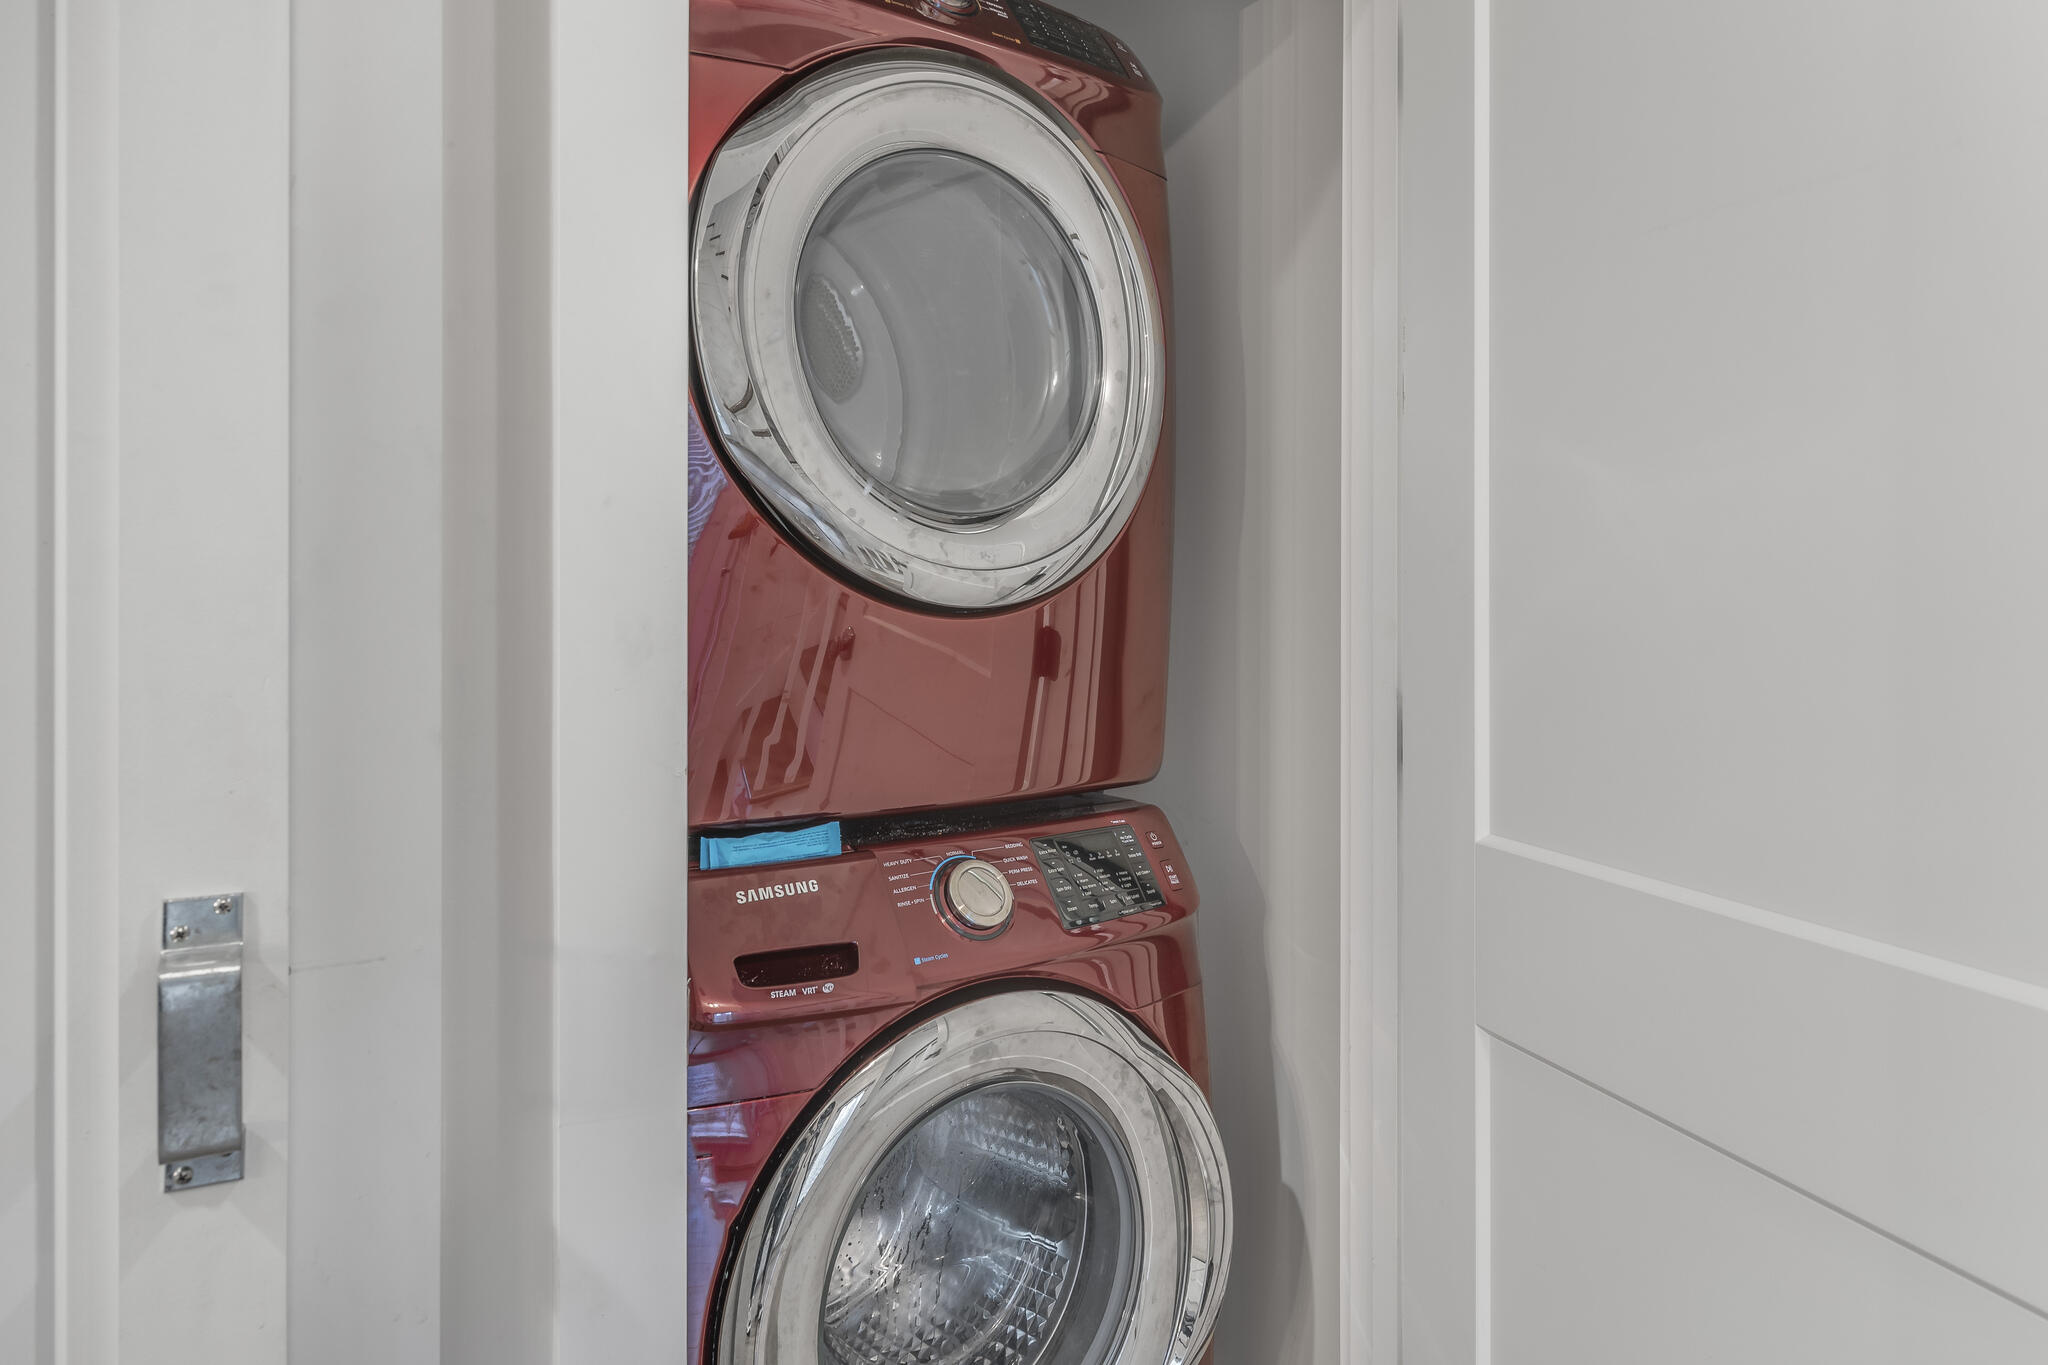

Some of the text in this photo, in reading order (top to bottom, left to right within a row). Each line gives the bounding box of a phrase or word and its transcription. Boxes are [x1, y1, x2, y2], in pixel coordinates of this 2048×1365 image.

[888, 873, 910, 881] SANITIZE
[736, 880, 819, 904] SAMSUNG
[893, 885, 917, 894] ALLERGEN
[770, 989, 797, 999] STEAM
